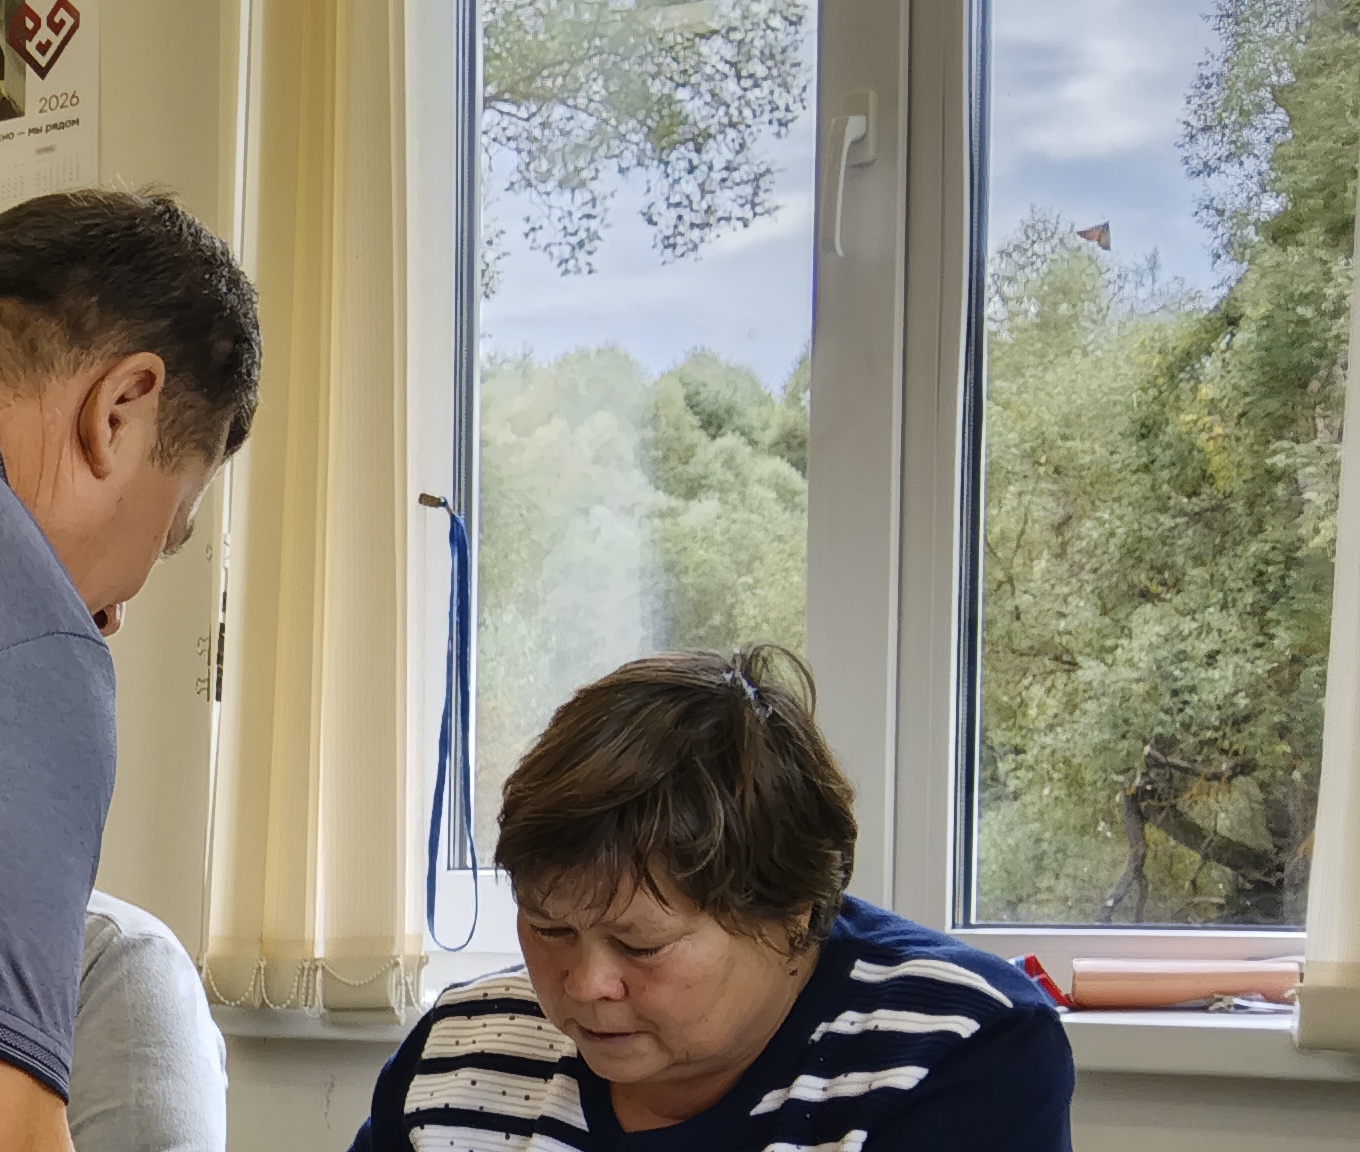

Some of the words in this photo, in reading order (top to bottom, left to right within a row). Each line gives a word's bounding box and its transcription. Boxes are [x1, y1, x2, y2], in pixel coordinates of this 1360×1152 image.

[38, 90, 80, 114] 2026
[27, 126, 43, 137] мы
[45, 118, 80, 134] рядом
